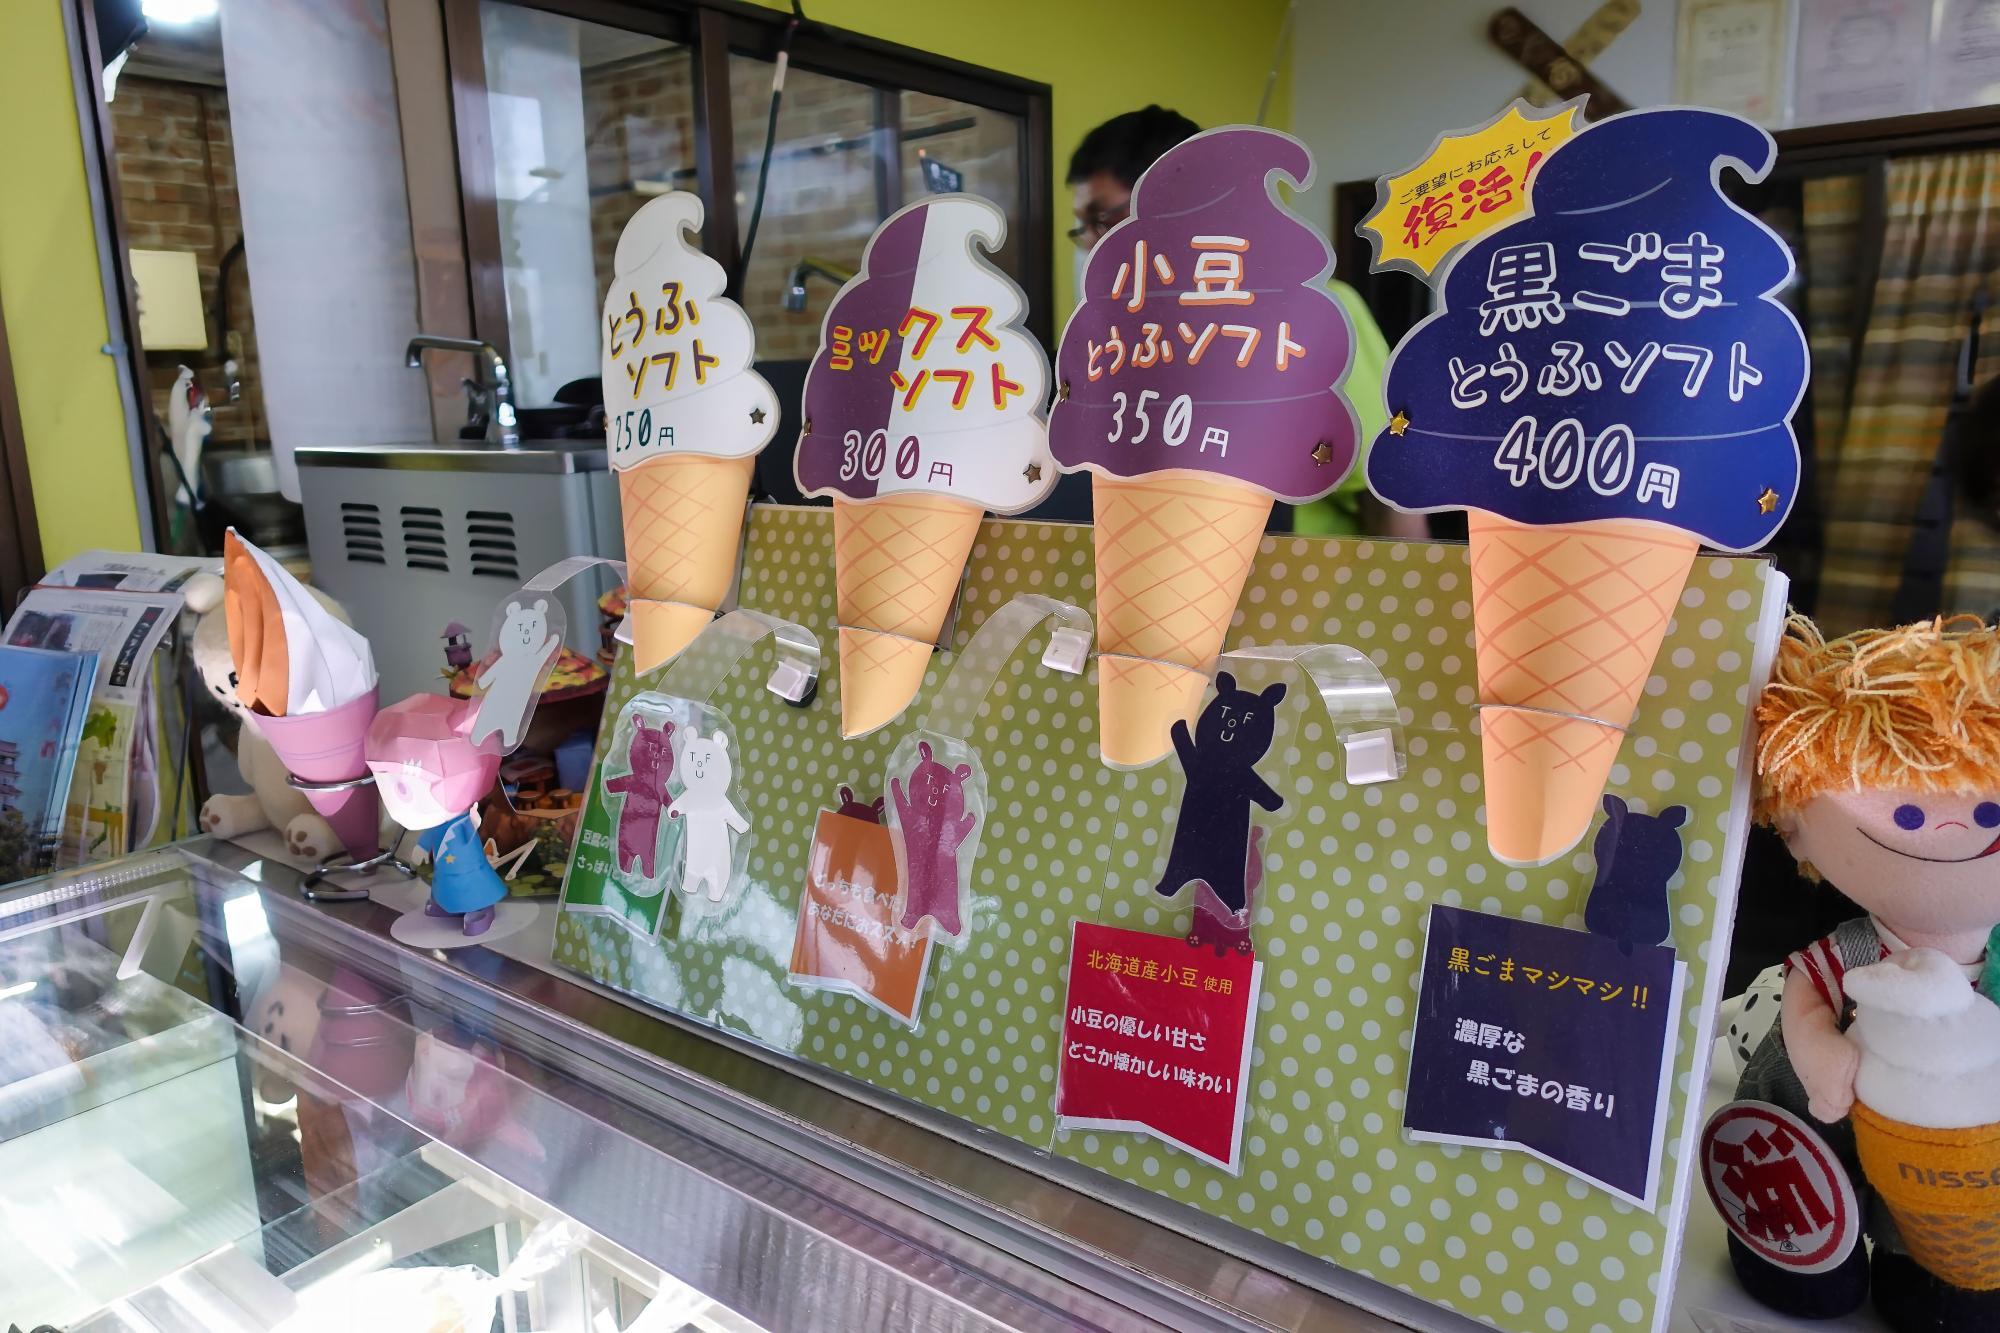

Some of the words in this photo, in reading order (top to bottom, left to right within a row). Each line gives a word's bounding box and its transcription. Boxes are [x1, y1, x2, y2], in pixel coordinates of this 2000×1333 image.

[1400, 127, 1552, 205] ご要望にお応えして
[1111, 235, 1255, 313] 小豆
[1479, 232, 1725, 336] 黒ごま
[606, 281, 699, 359] とうふ
[830, 305, 1000, 371] ミックス
[626, 338, 720, 400] ソフト
[1087, 321, 1307, 383] とうふソフト
[1448, 340, 1763, 409] とうふソフト
[889, 362, 1025, 412] ソフト
[615, 407, 675, 453] 250円
[1107, 389, 1230, 458] 350円
[839, 427, 953, 486] 300円
[1494, 415, 1681, 510] 400円
[1071, 1005, 1207, 1052] 小豆の優しい甘さ
[1454, 1017, 1526, 1054] 濃厚な
[1068, 1041, 1231, 1094] どこか懐かしい味わい
[1466, 1059, 1615, 1118] 黒ごまの香り
